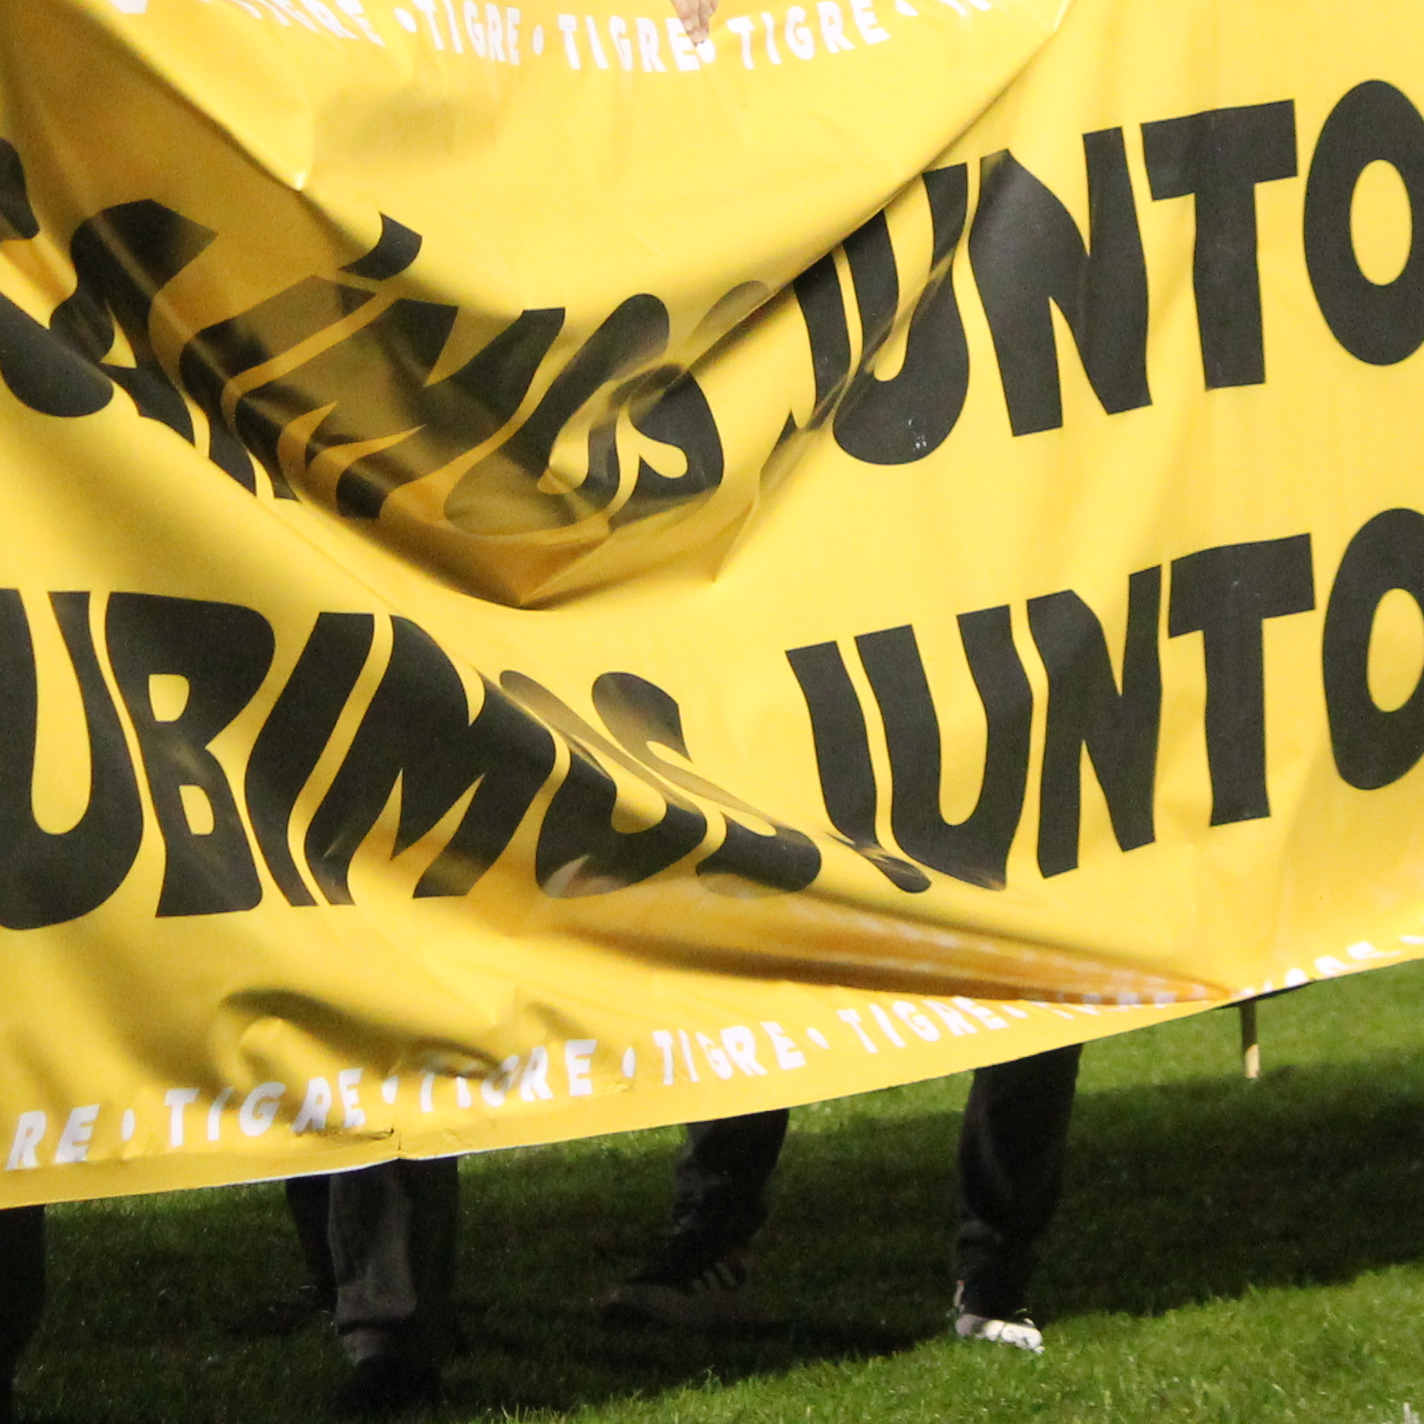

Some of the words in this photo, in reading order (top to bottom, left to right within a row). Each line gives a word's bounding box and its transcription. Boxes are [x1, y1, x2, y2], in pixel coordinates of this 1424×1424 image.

[557, 12, 702, 73] TIGRE
[164, 1067, 366, 1148] TIGRE
[653, 1020, 808, 1087] TIGRE
[837, 995, 1010, 1055] TIGRE
